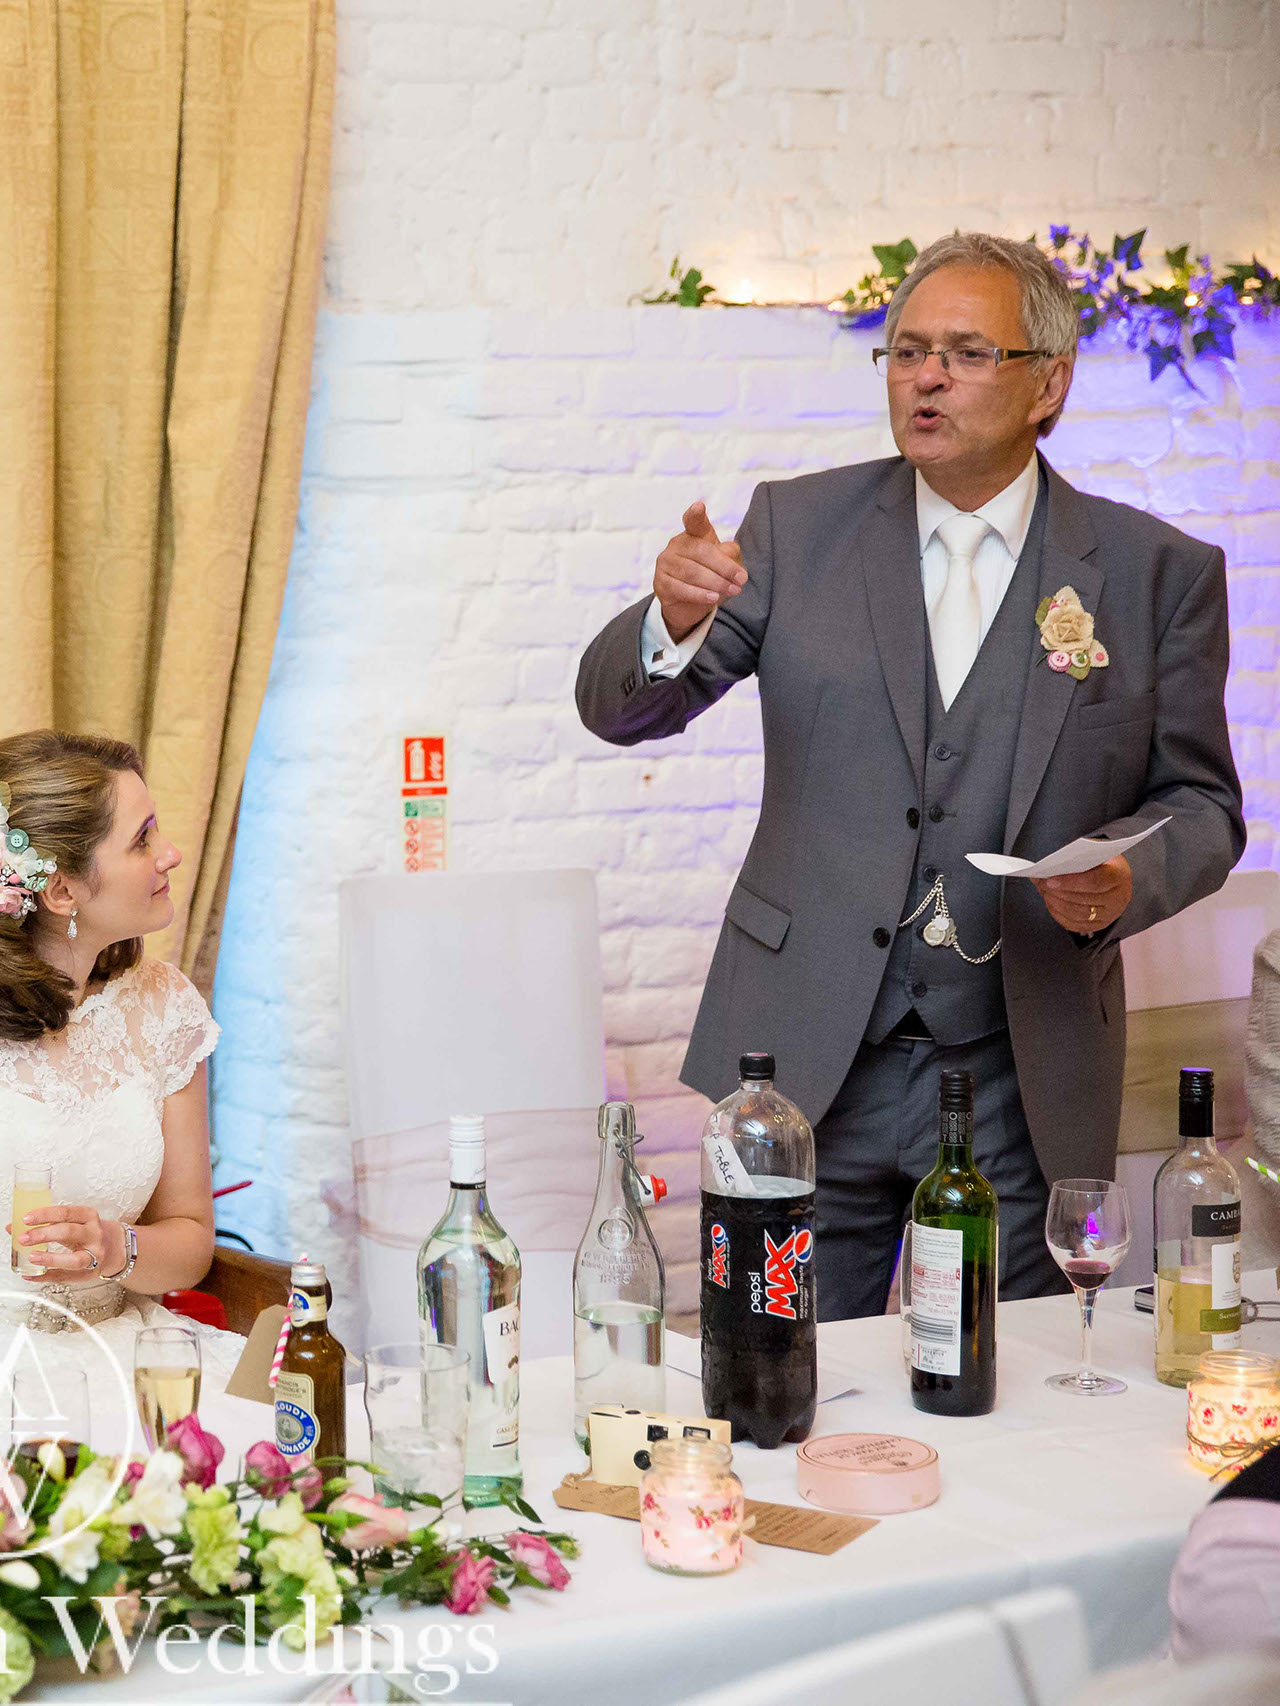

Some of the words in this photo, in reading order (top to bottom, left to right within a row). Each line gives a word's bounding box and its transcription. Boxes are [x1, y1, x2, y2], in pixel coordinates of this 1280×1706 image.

[714, 1145, 735, 1185] TABLE
[712, 1240, 727, 1289] MAX
[764, 1228, 799, 1320] MAX
[748, 1271, 763, 1313] pepsi
